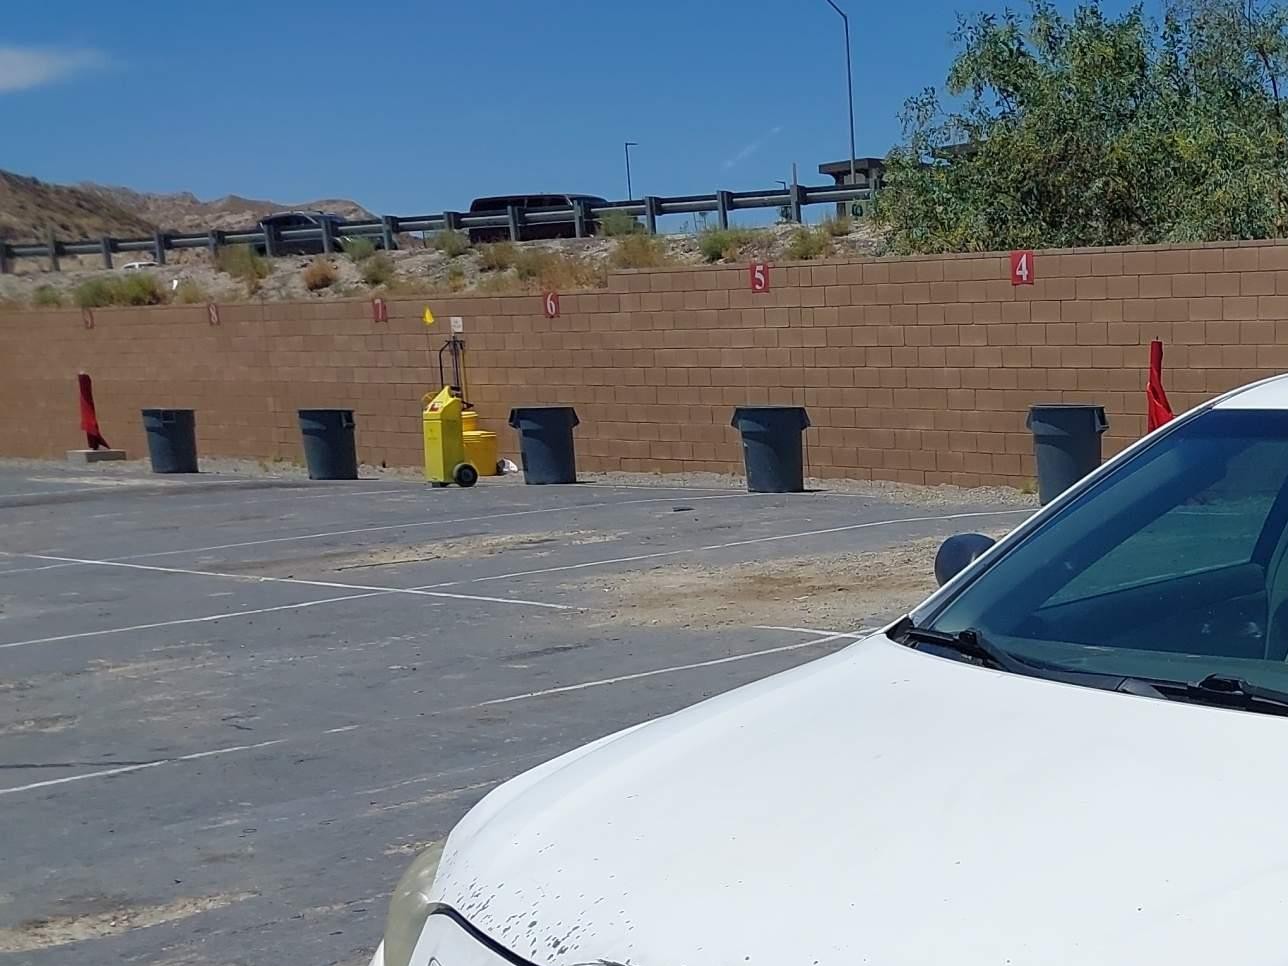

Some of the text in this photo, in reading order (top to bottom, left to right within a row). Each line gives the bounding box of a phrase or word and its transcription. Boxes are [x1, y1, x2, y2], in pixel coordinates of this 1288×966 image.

[754, 265, 765, 290] 5
[1016, 253, 1028, 281] 4
[209, 303, 218, 324] 8
[374, 298, 382, 320] 7
[547, 293, 555, 315] 6
